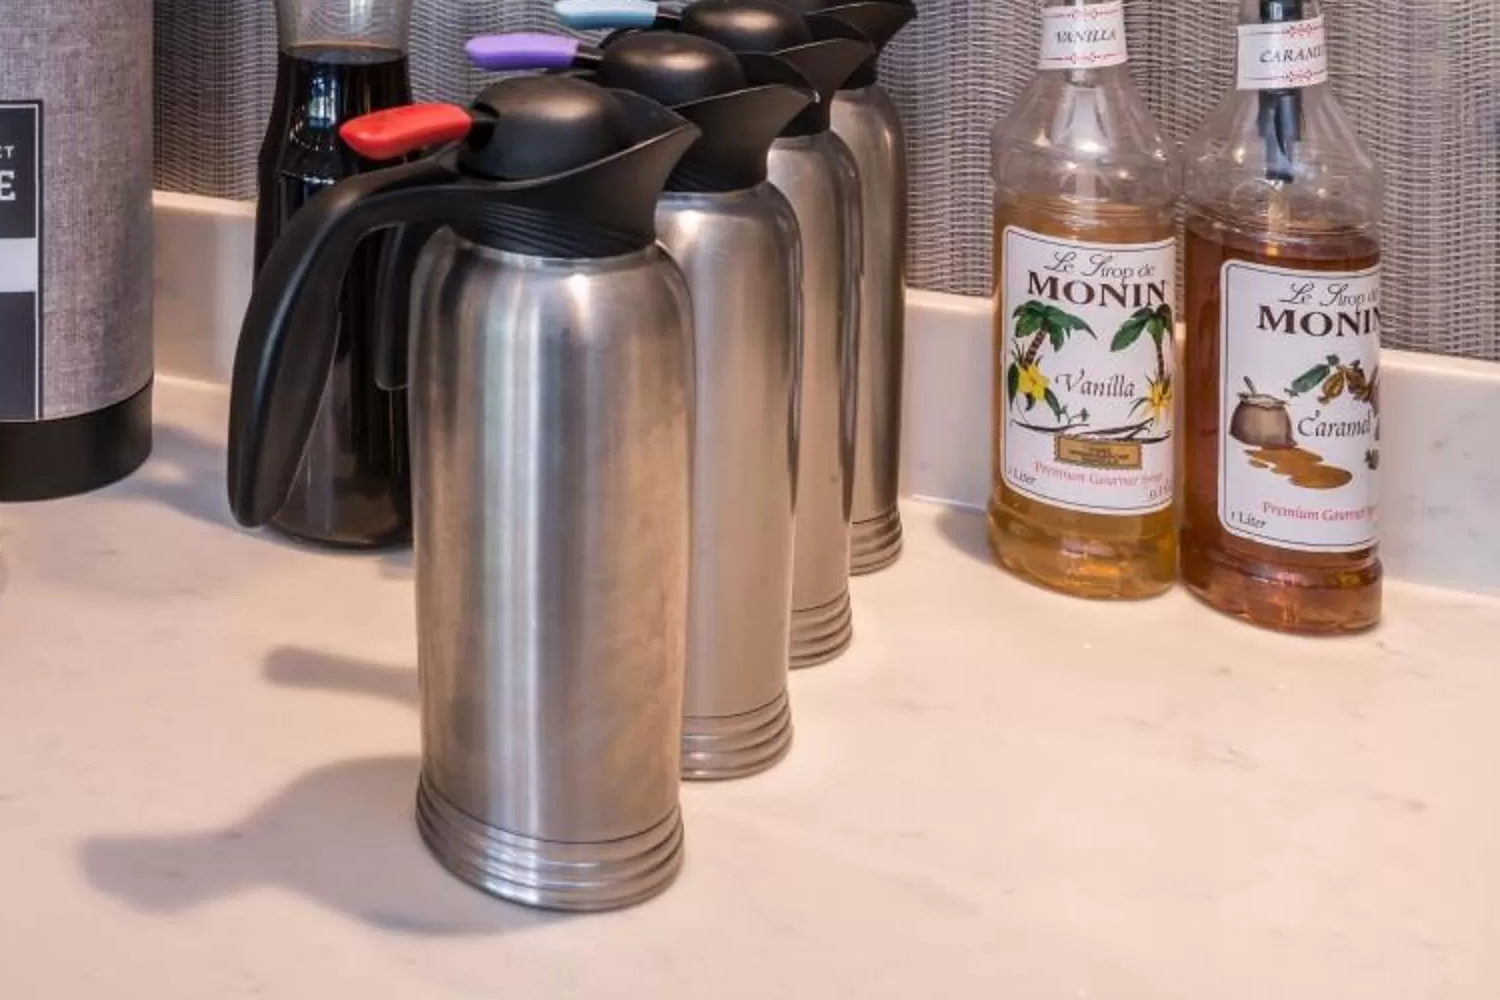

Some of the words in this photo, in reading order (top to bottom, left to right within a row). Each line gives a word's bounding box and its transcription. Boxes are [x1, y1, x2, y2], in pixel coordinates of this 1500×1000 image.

[1056, 29, 1116, 44] VANILLA
[1043, 251, 1077, 273] Le
[1028, 270, 1167, 308] MONIN
[1278, 281, 1315, 304] Le
[1055, 368, 1136, 397] Vanilla
[1297, 409, 1372, 437] Caramel
[1261, 501, 1319, 521] Premium
